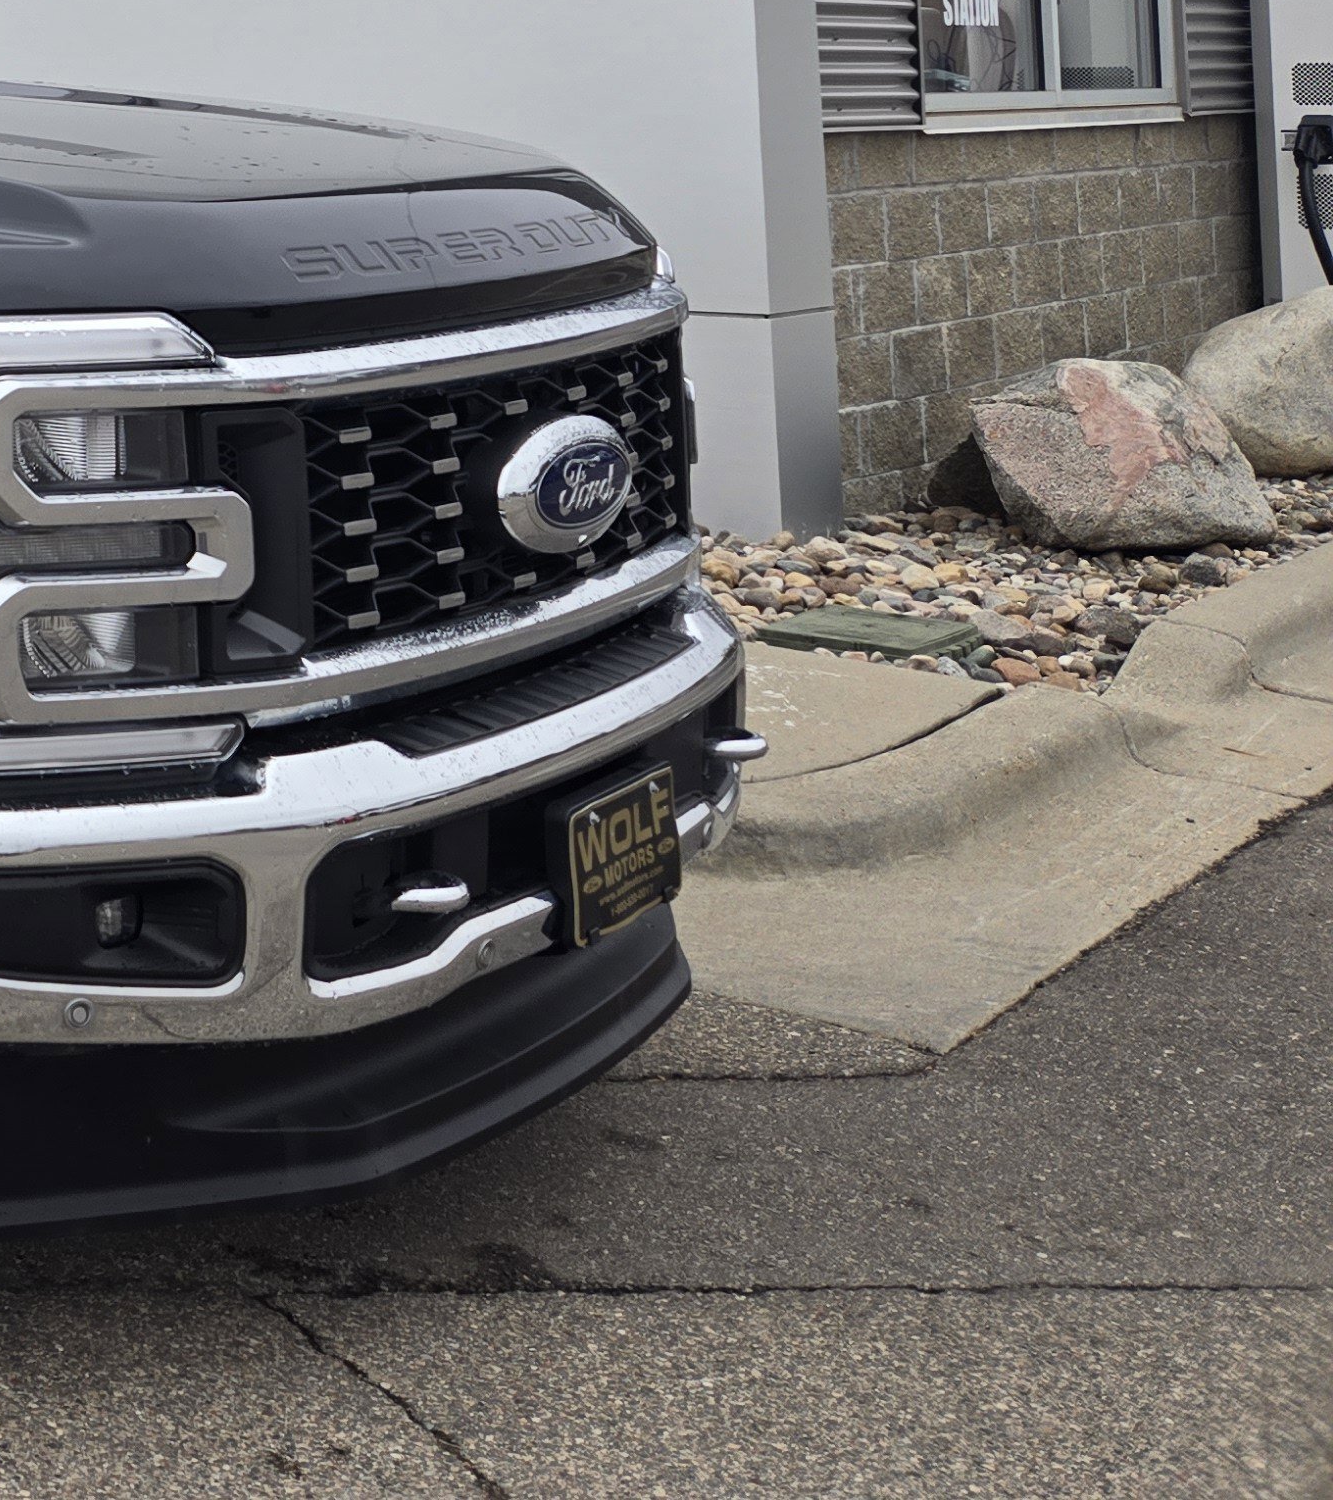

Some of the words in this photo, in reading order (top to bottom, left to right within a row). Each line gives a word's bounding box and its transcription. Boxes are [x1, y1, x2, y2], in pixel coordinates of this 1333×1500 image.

[280, 227, 525, 283] SUPER
[518, 206, 627, 255] DUTY
[559, 456, 621, 517] Ford
[577, 787, 671, 873] WOLF
[603, 843, 656, 889] MOTORS
